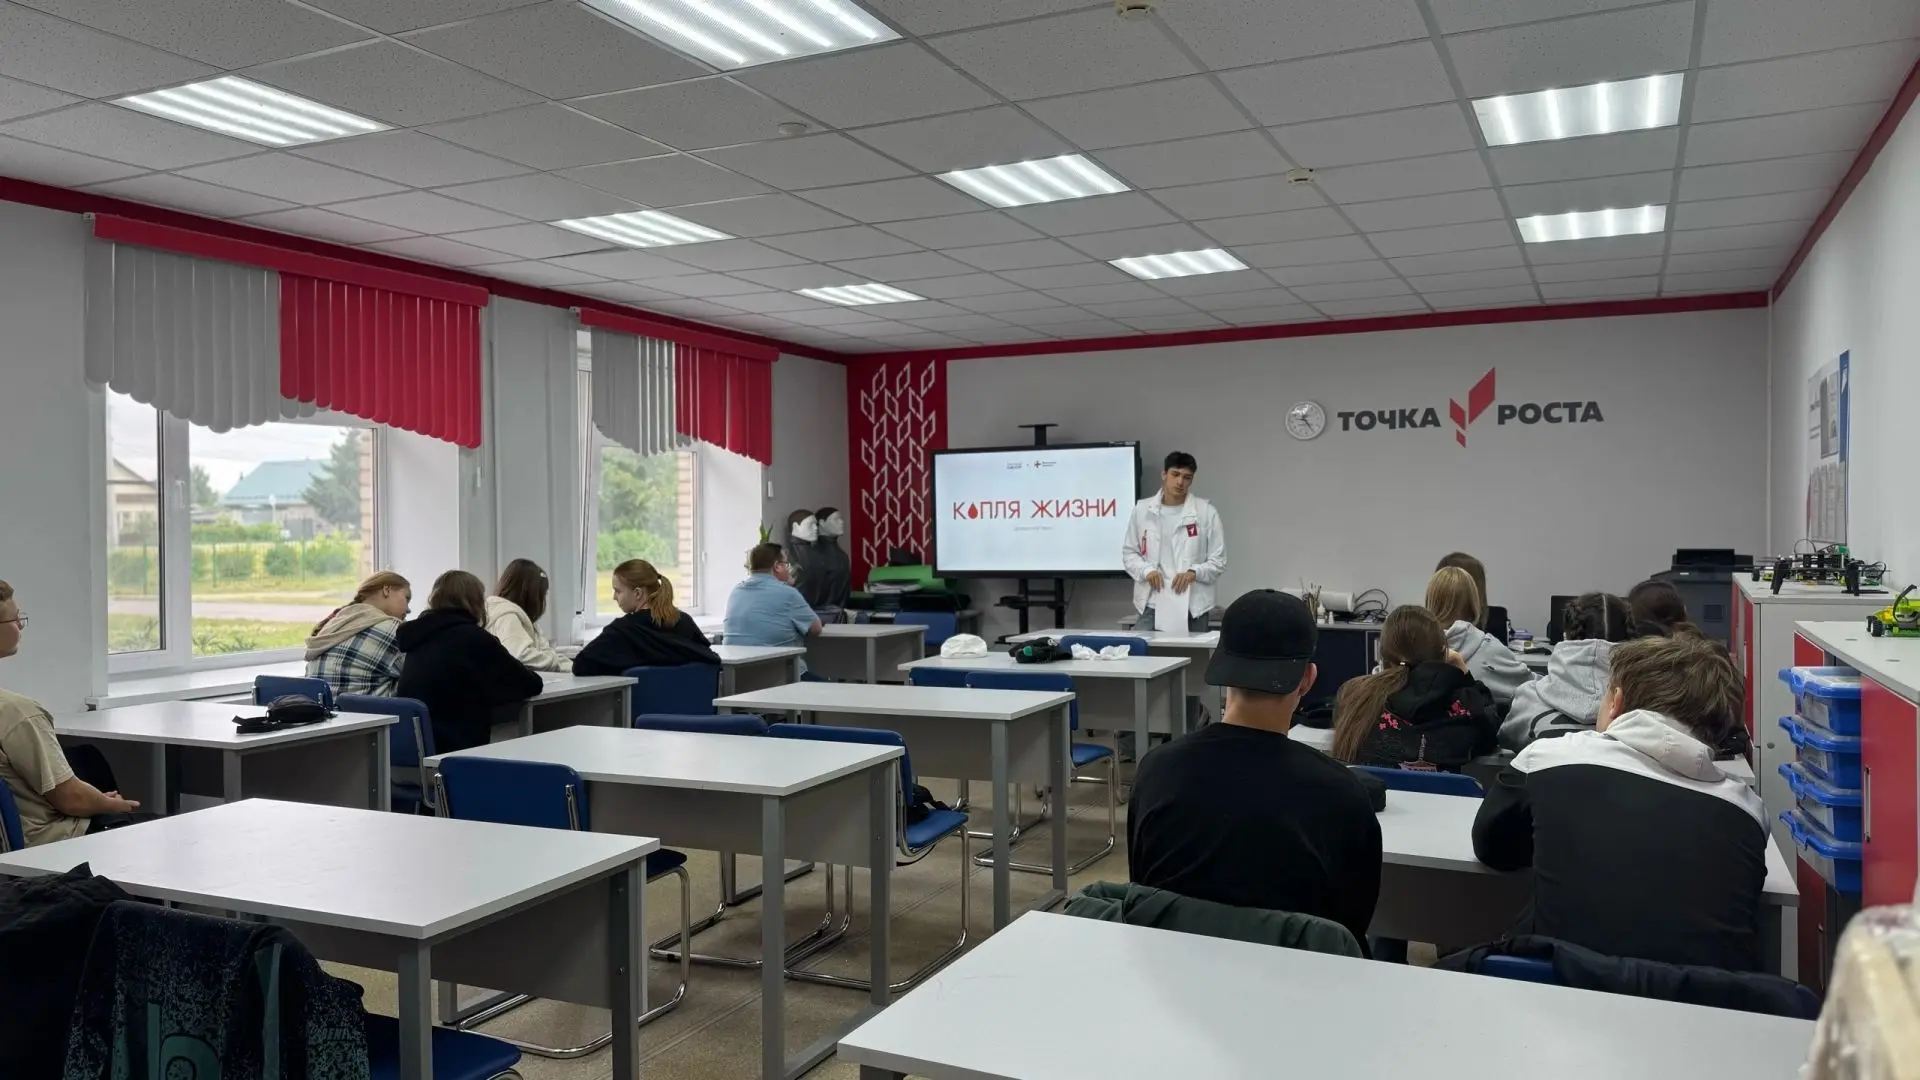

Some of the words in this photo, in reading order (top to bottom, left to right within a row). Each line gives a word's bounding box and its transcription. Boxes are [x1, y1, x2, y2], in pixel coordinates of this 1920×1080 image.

[1337, 407, 1441, 432] ТОЧКА
[1497, 400, 1605, 426] РОСТА
[1030, 498, 1117, 519] ЖИЗНИ
